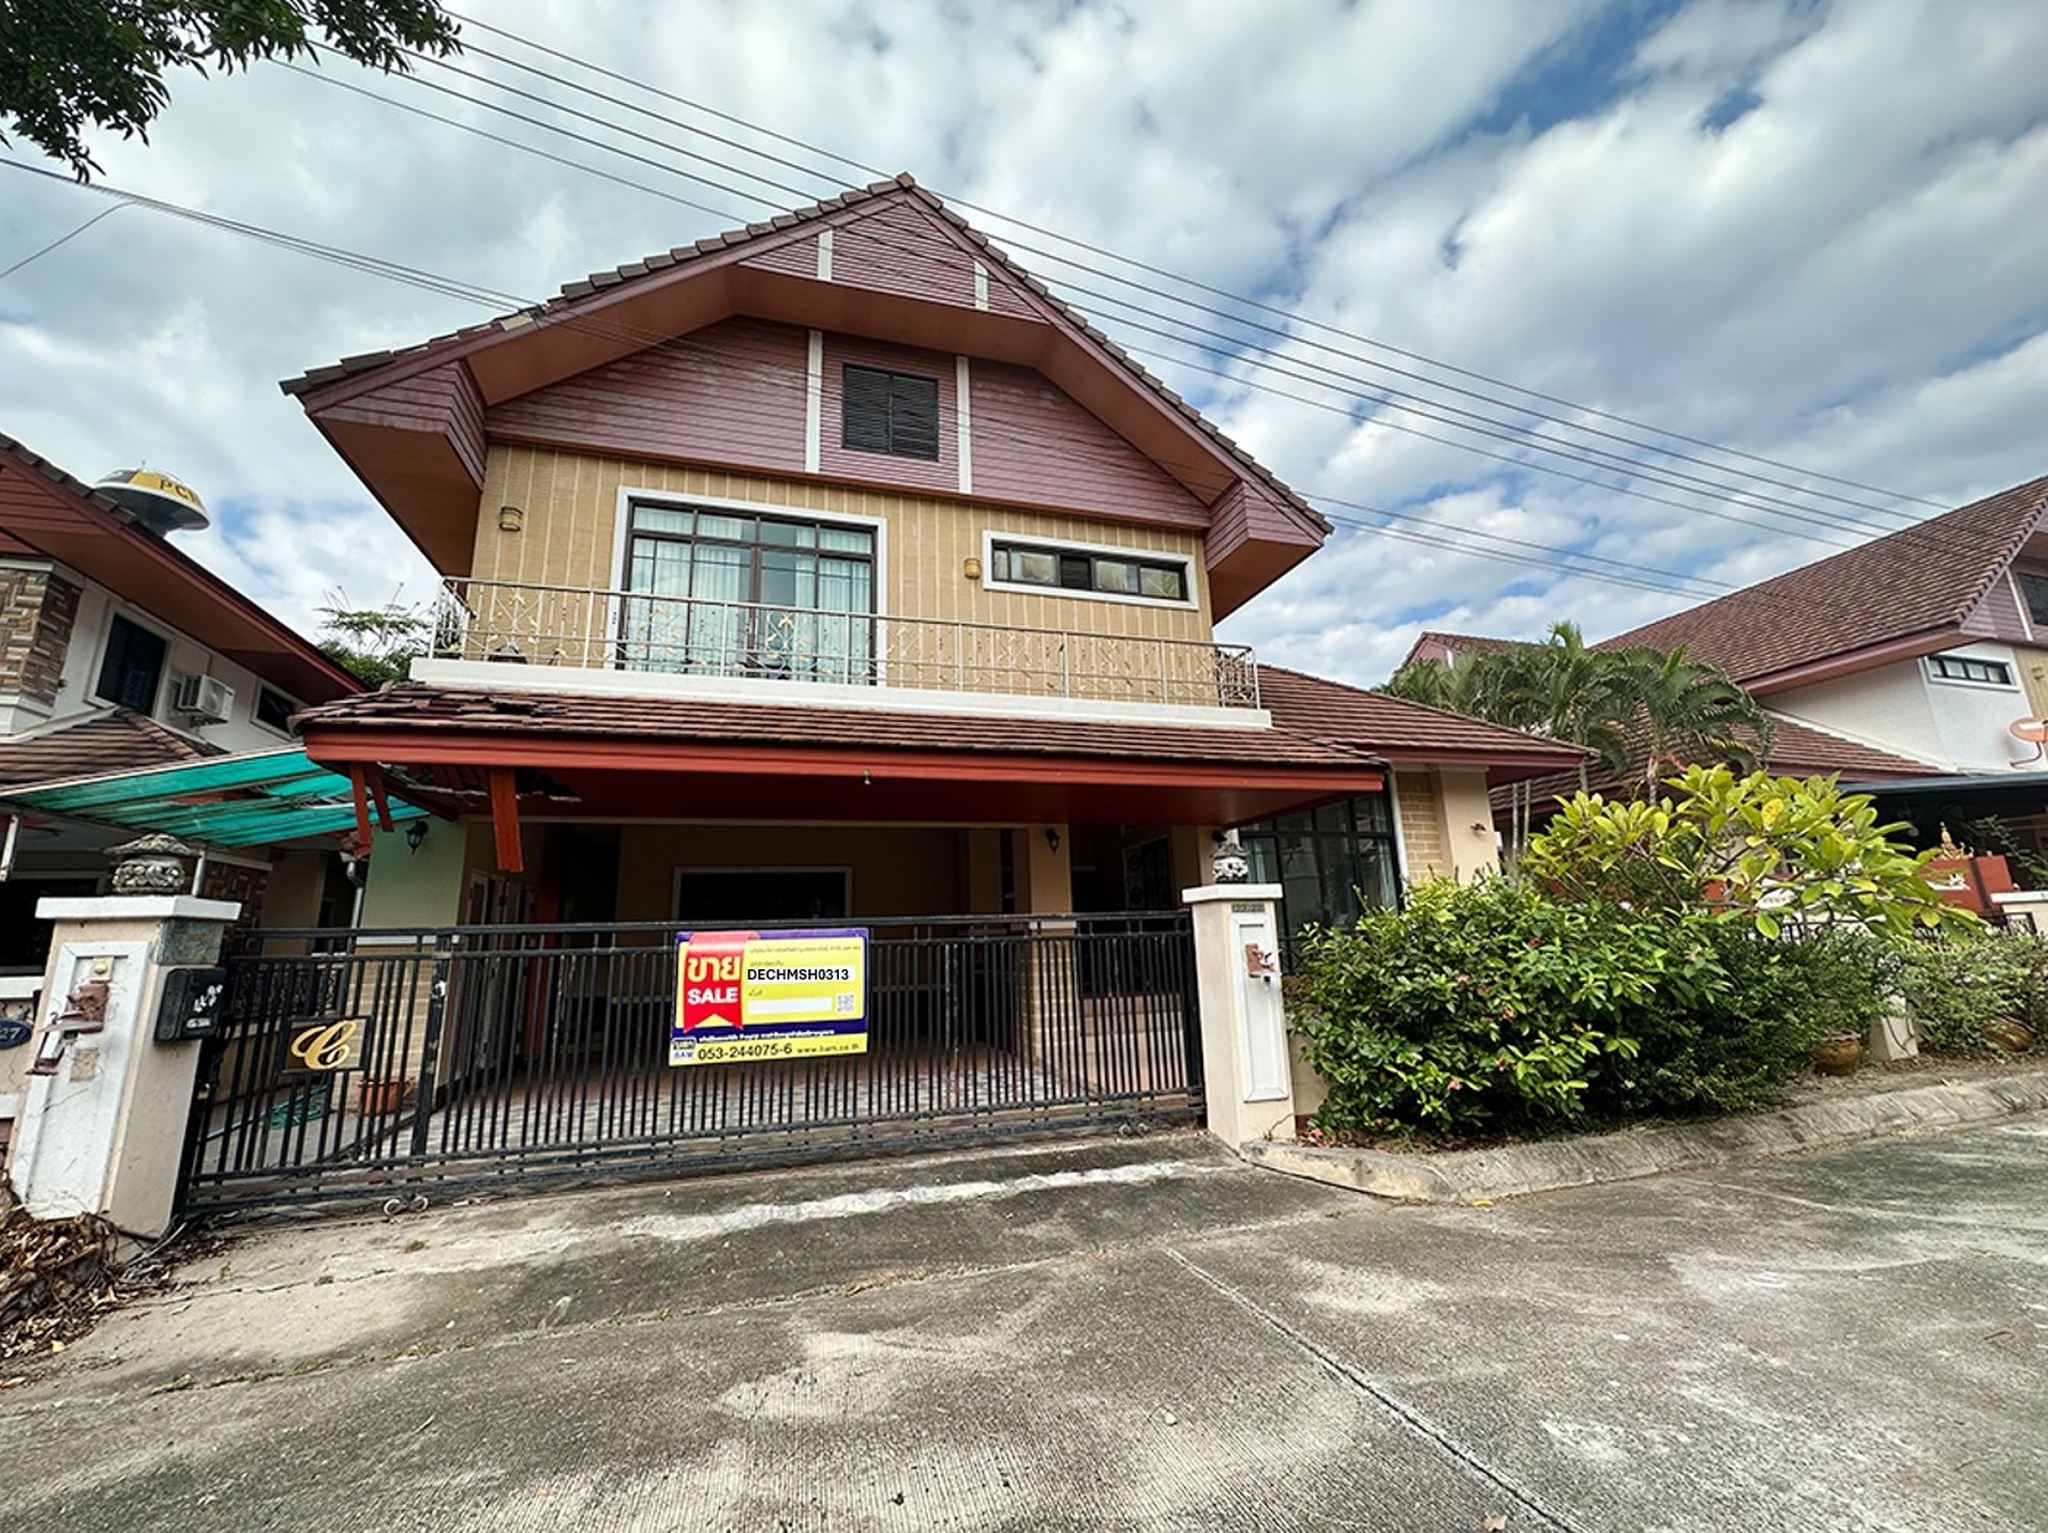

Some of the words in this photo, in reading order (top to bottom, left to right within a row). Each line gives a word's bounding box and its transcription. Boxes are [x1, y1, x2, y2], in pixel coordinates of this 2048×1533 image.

[688, 956, 740, 983] ขาย
[747, 968, 849, 981] DECHMSH0313
[688, 987, 739, 1005] SALE
[698, 1043, 793, 1060] 053-244075-6
